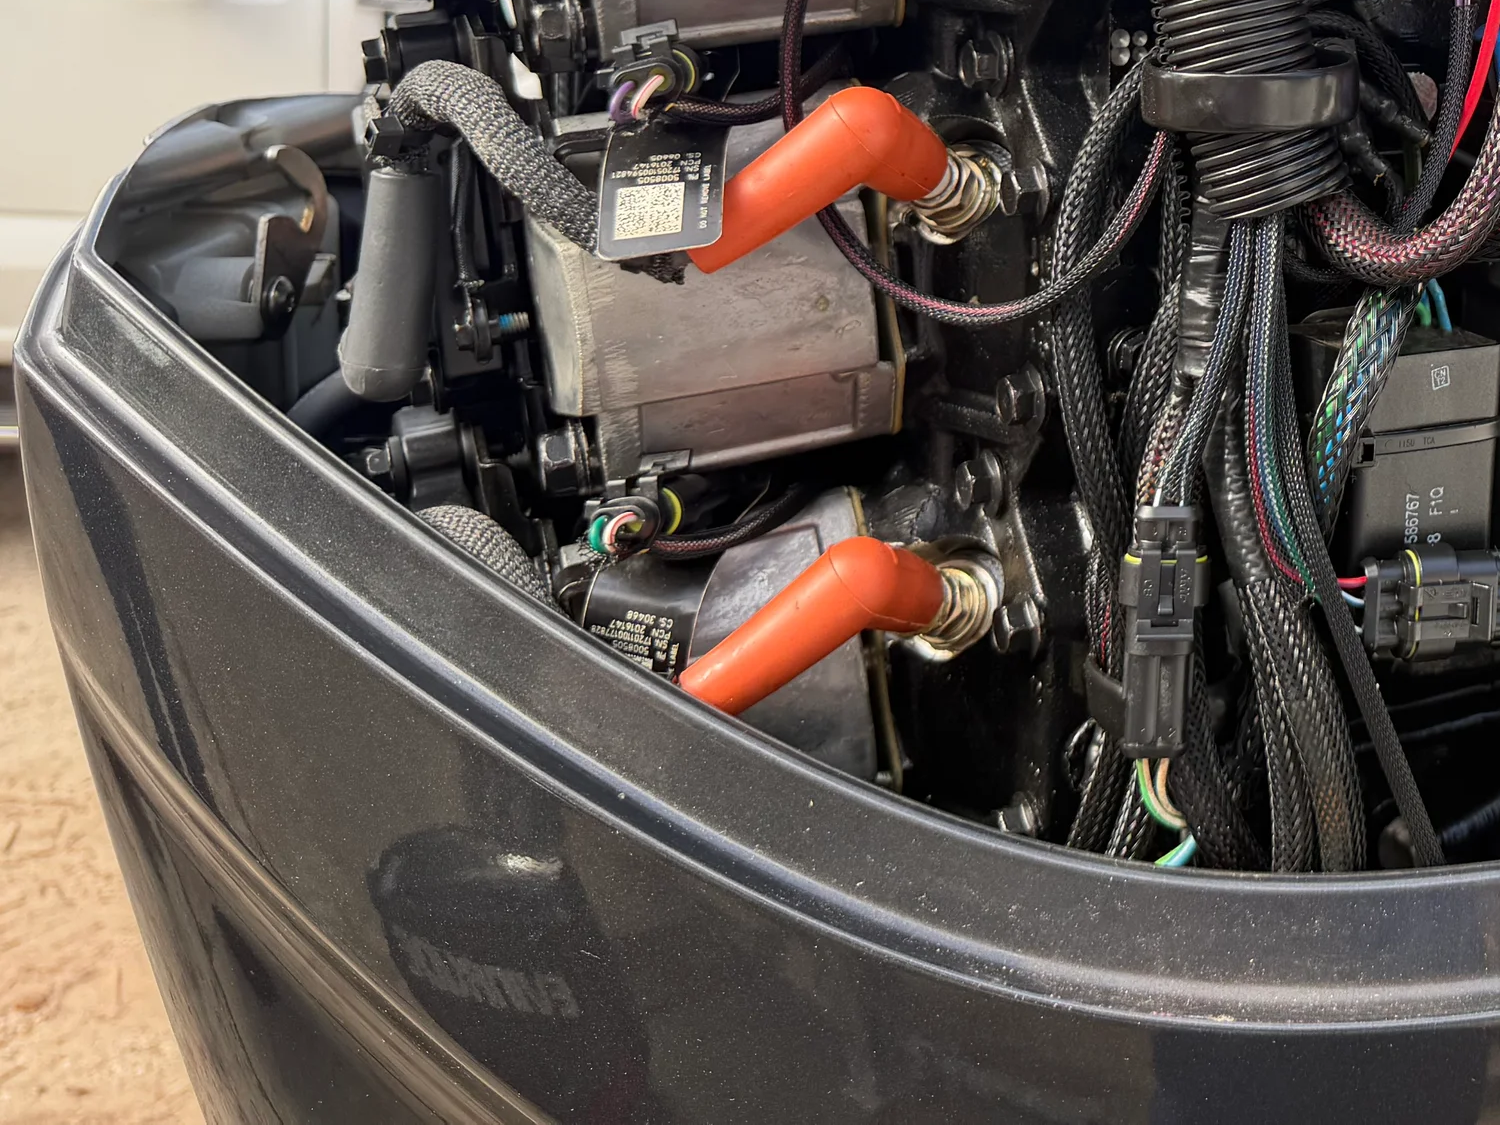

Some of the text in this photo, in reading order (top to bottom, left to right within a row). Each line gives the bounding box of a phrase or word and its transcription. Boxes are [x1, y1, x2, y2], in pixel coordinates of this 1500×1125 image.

[632, 159, 672, 170] 2016147
[636, 173, 679, 184] 5008505
[1427, 484, 1444, 516] F1Q
[1402, 493, 1421, 544] 586767
[625, 609, 655, 623] 30468
[608, 618, 645, 633] 2016147
[611, 639, 649, 654] 5008505
